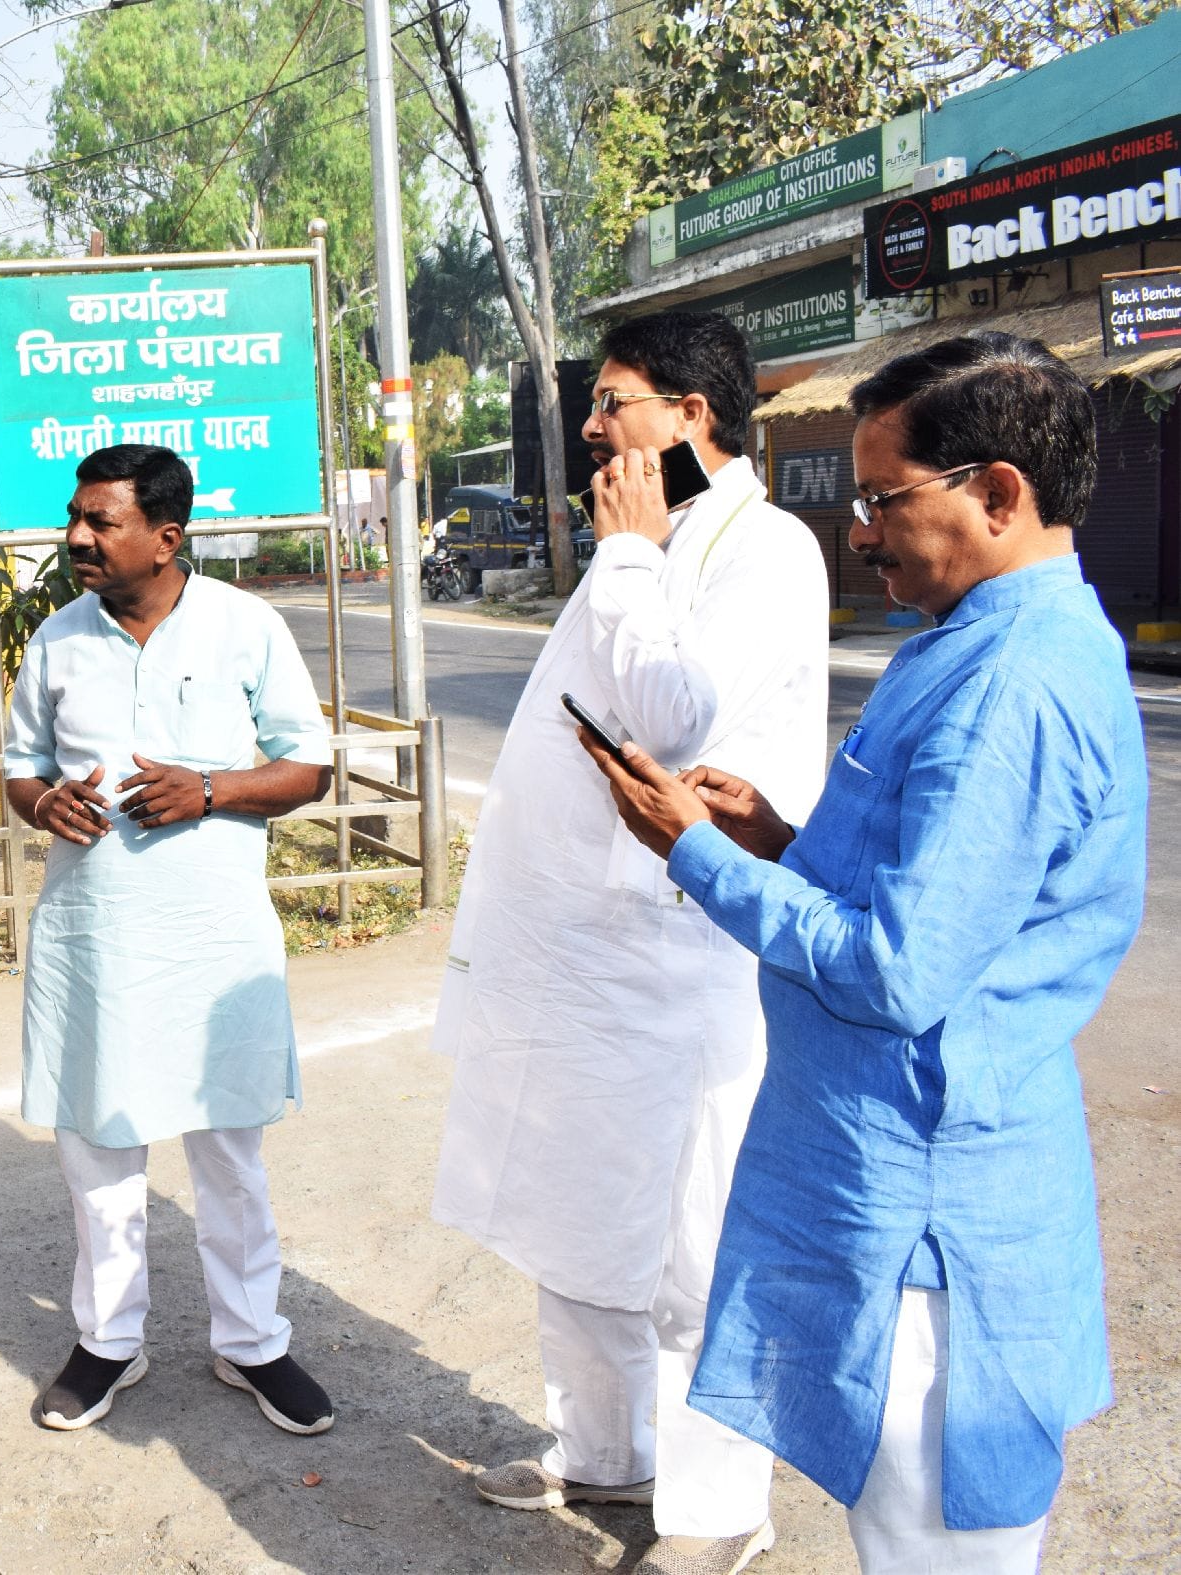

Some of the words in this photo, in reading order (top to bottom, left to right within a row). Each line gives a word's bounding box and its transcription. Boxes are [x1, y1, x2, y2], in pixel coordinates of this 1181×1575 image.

[707, 173, 776, 208] SHAHJAHANPUR
[780, 159, 801, 182] CITY
[803, 146, 838, 176] OFFICE
[885, 150, 919, 166] FUTURE
[679, 207, 721, 241] FUTURE
[723, 192, 763, 226] GROUP
[766, 186, 782, 211] OF
[785, 154, 876, 205] INSTITUTIONS
[930, 189, 967, 213] SOUTH
[1016, 164, 1058, 190] NORTH
[884, 233, 898, 245] BACK
[899, 226, 925, 241] BENCHERS
[905, 239, 924, 252] FAMILY
[947, 206, 1047, 270] Back
[66, 277, 229, 325] कार्यालय
[724, 301, 745, 316] OFFICE
[746, 311, 761, 332] OF
[764, 289, 847, 328] INSTITUTIONS
[1112, 288, 1140, 306] Back
[15, 329, 128, 376] जिला
[136, 325, 283, 369] पंचायत
[91, 373, 216, 407] शाहजहाँपुर
[30, 414, 116, 460] श्रीमती
[202, 415, 271, 451] यादव
